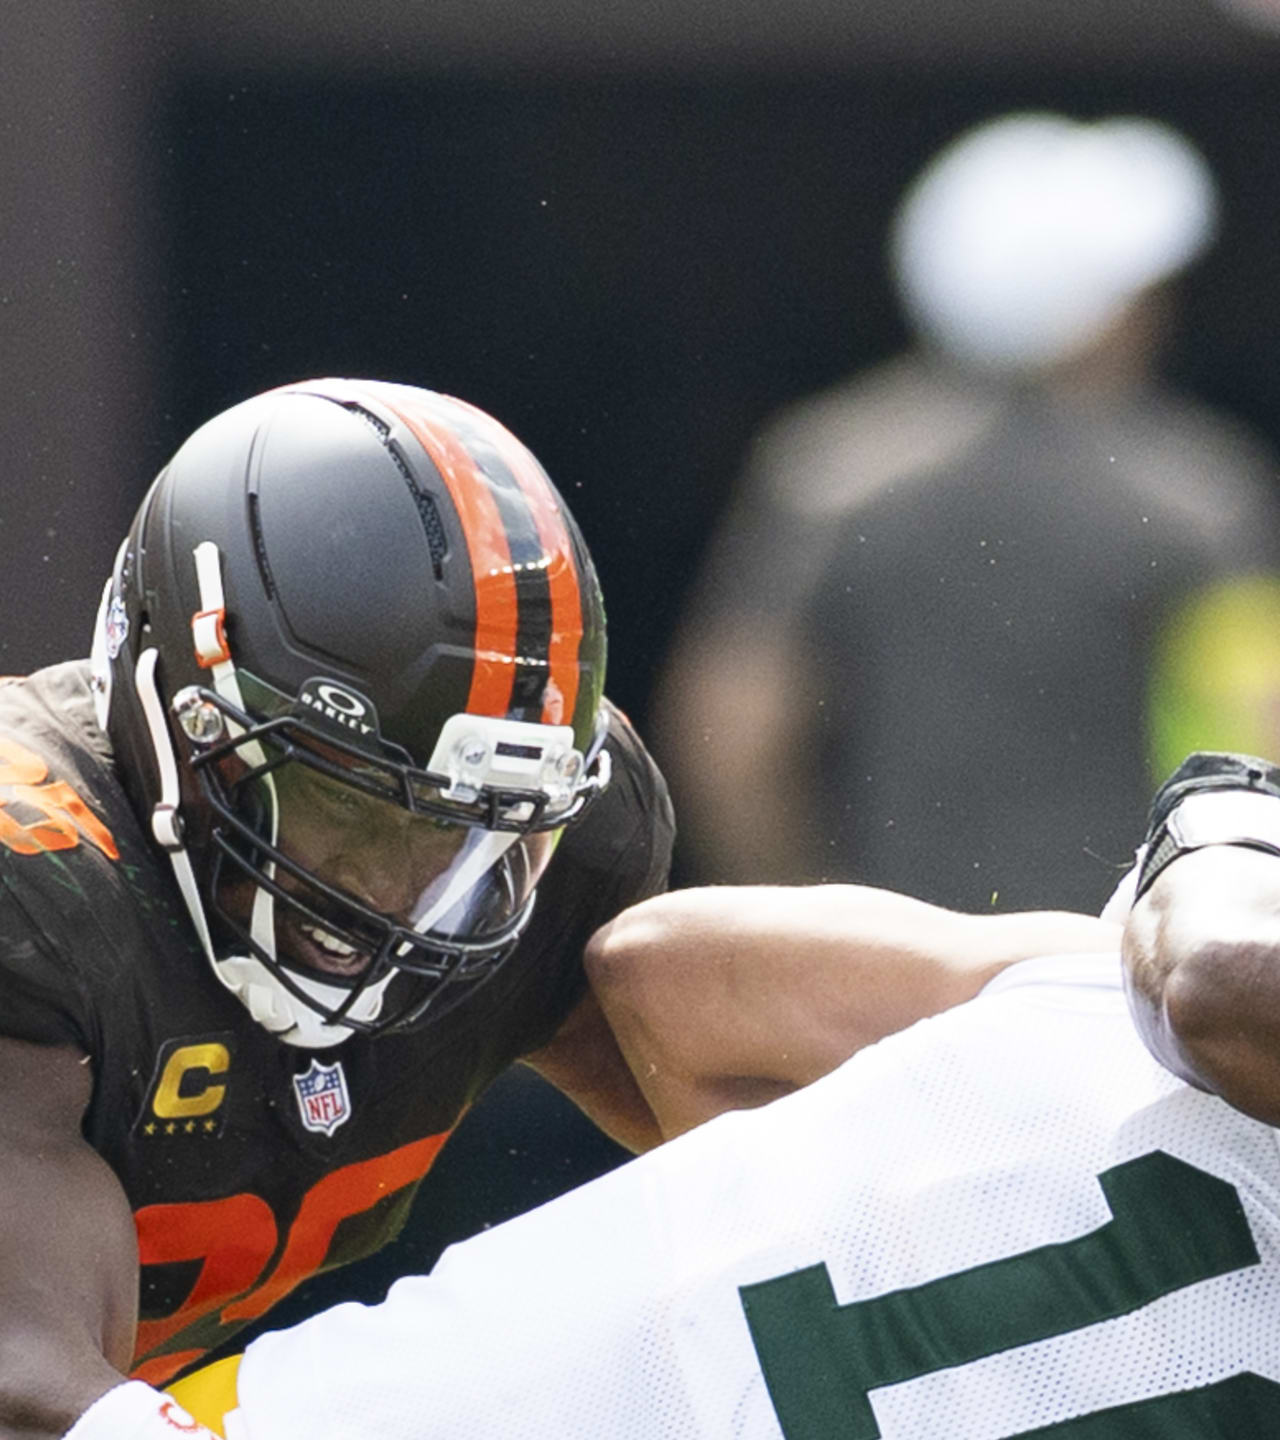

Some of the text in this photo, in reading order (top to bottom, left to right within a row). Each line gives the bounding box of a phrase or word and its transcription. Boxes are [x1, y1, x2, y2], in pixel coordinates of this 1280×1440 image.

[301, 692, 375, 735] OAKLEY
[152, 1042, 230, 1118] C
[307, 1092, 343, 1121] NFL
